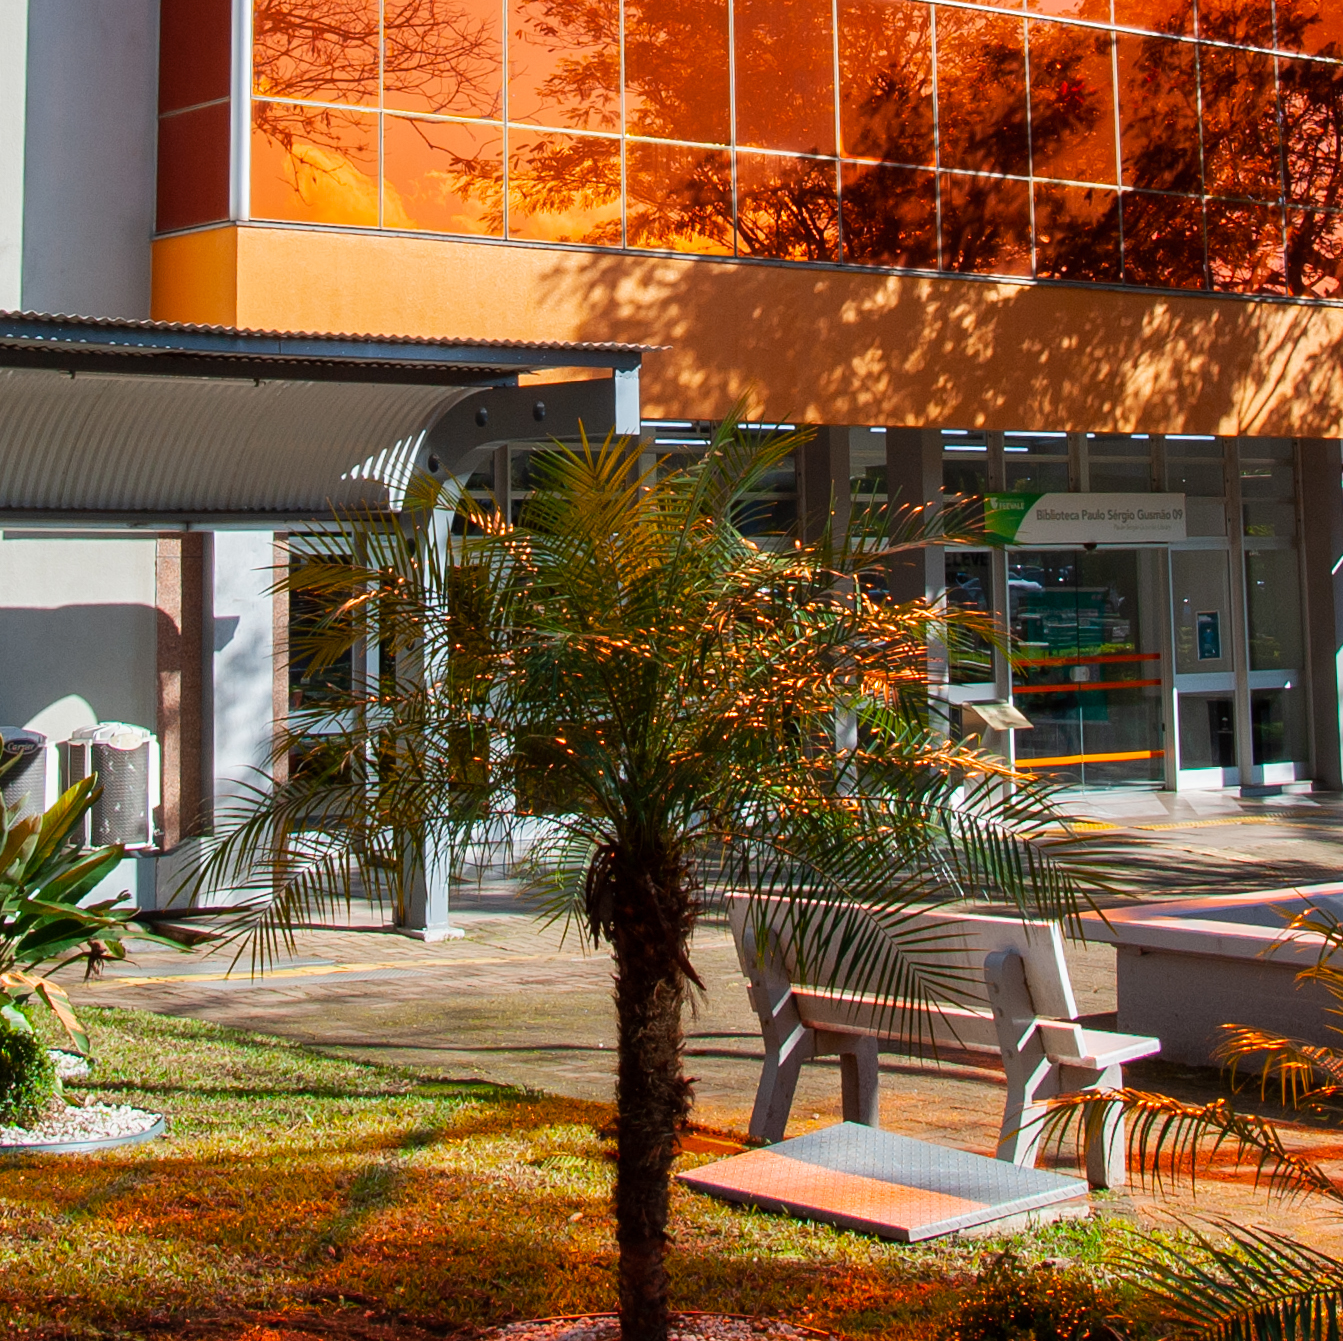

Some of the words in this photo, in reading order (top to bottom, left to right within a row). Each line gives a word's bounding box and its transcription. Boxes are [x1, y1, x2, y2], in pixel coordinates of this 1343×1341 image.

[1036, 509, 1080, 521] Biblioteca
[1082, 509, 1106, 521] Paulo
[1107, 508, 1135, 524] Sérgio
[1137, 508, 1171, 521] Gusmão
[1172, 508, 1184, 520] 09
